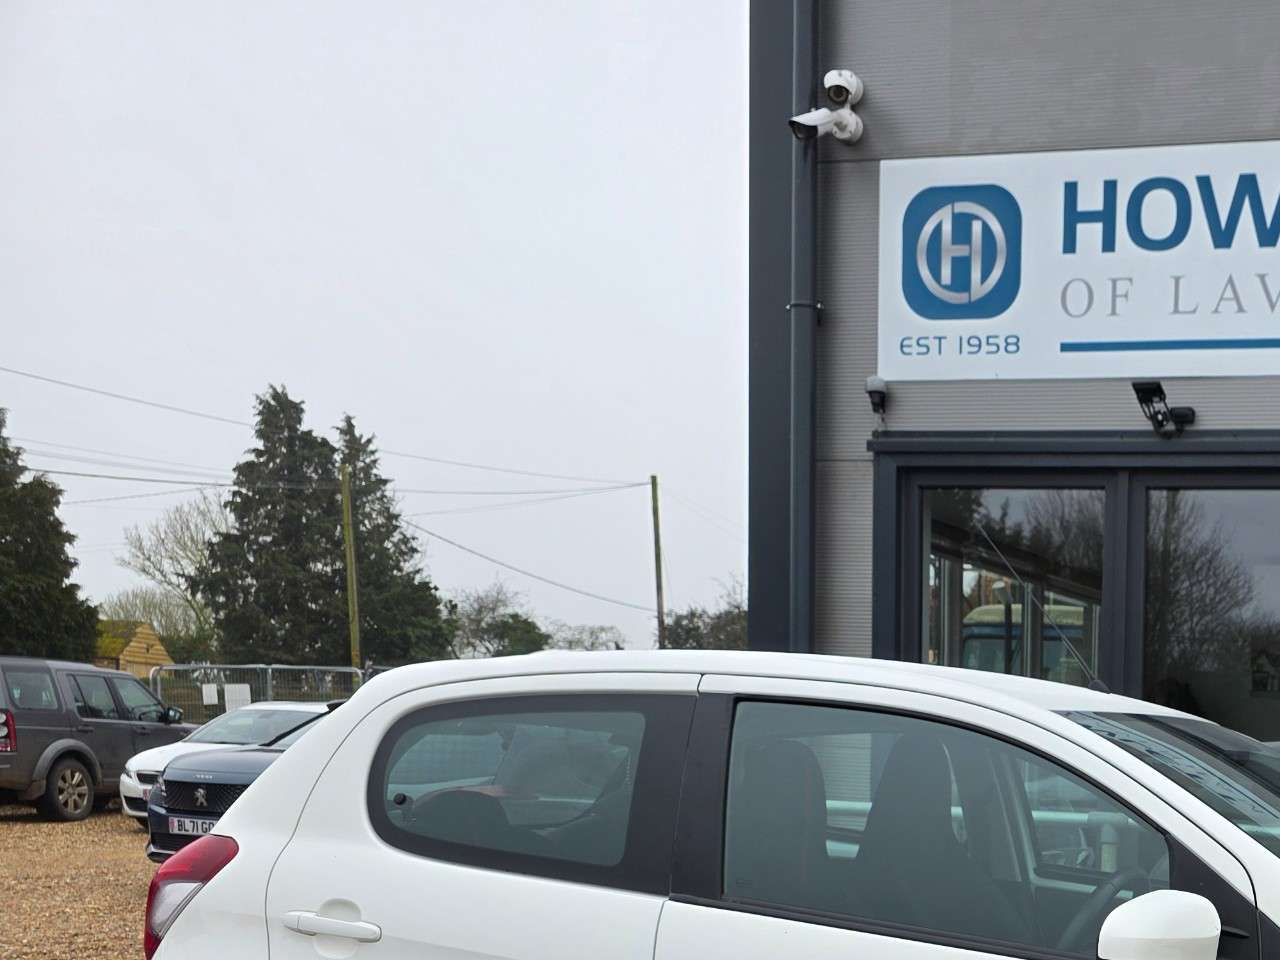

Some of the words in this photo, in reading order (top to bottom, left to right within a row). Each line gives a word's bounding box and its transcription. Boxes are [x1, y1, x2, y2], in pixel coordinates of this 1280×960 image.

[1060, 276, 1134, 319] OF
[899, 335, 948, 356] EST
[959, 334, 1020, 355] 1958
[177, 819, 199, 833] BL71
